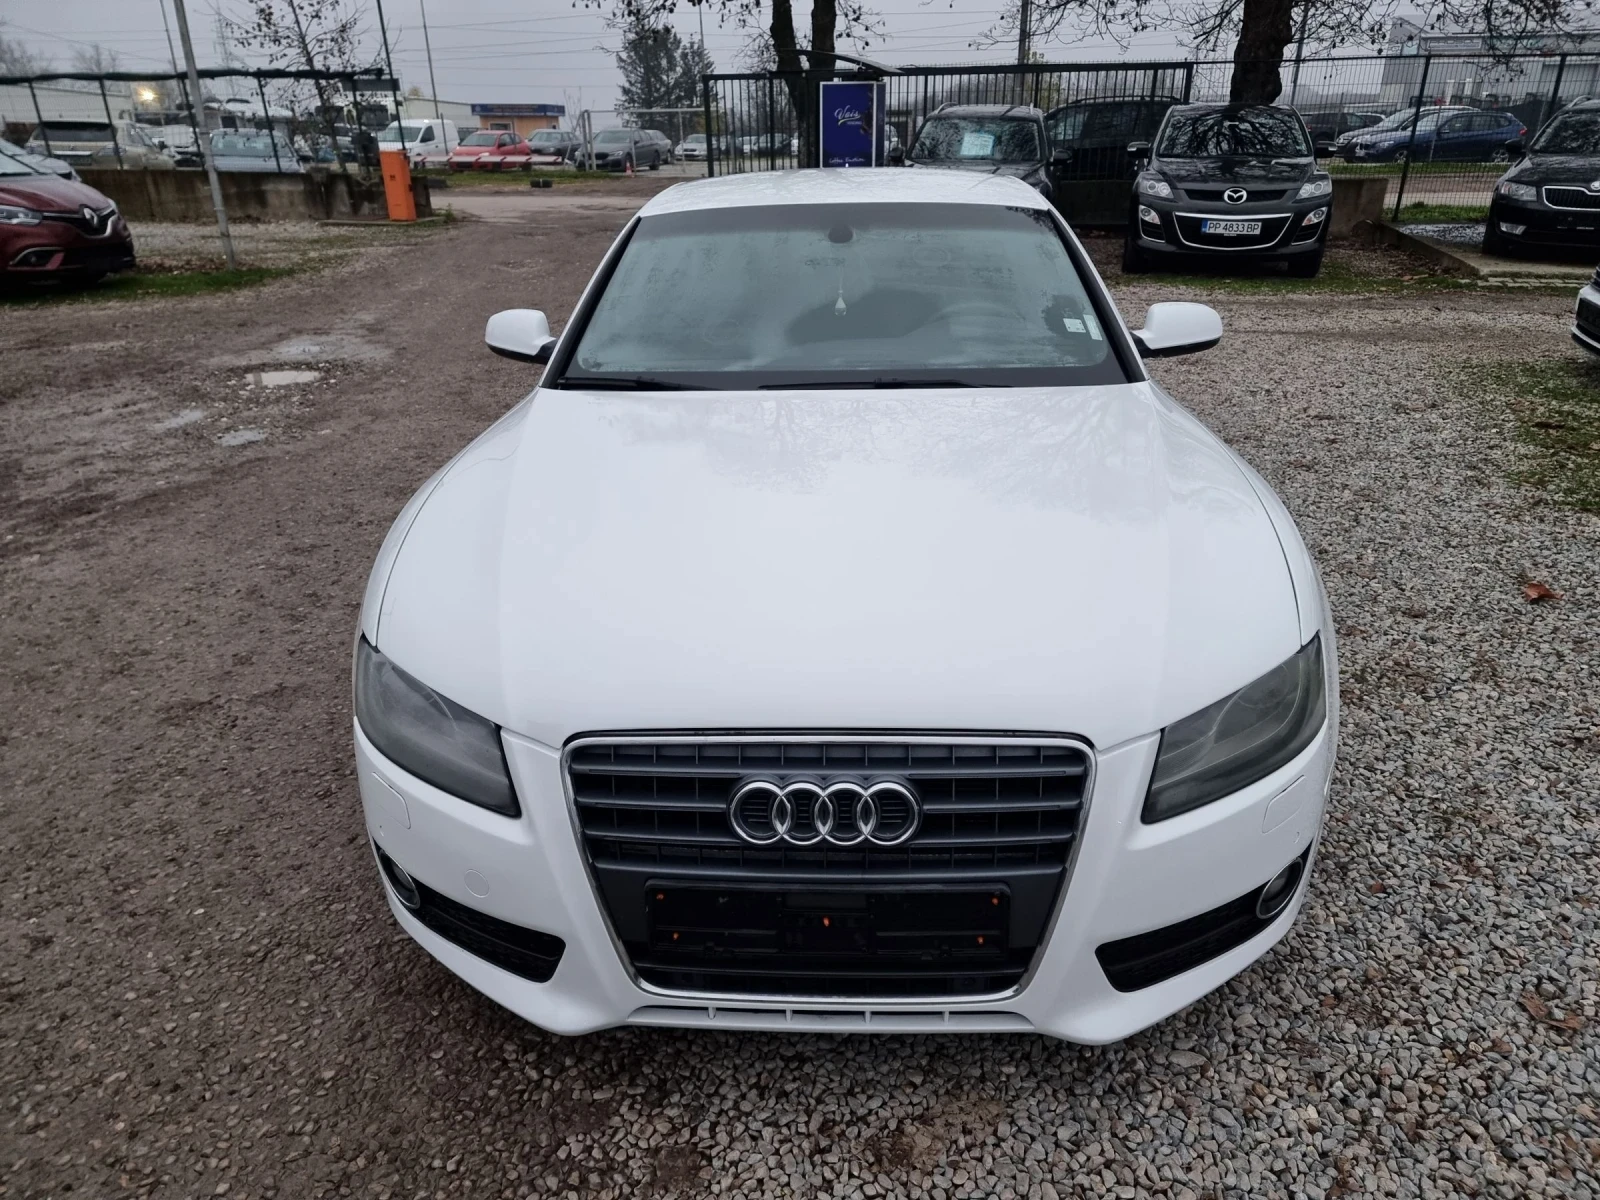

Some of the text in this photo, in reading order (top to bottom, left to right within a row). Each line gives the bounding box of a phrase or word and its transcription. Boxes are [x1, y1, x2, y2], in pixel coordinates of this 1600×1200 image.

[1208, 222, 1260, 233] PP 4833 BP
